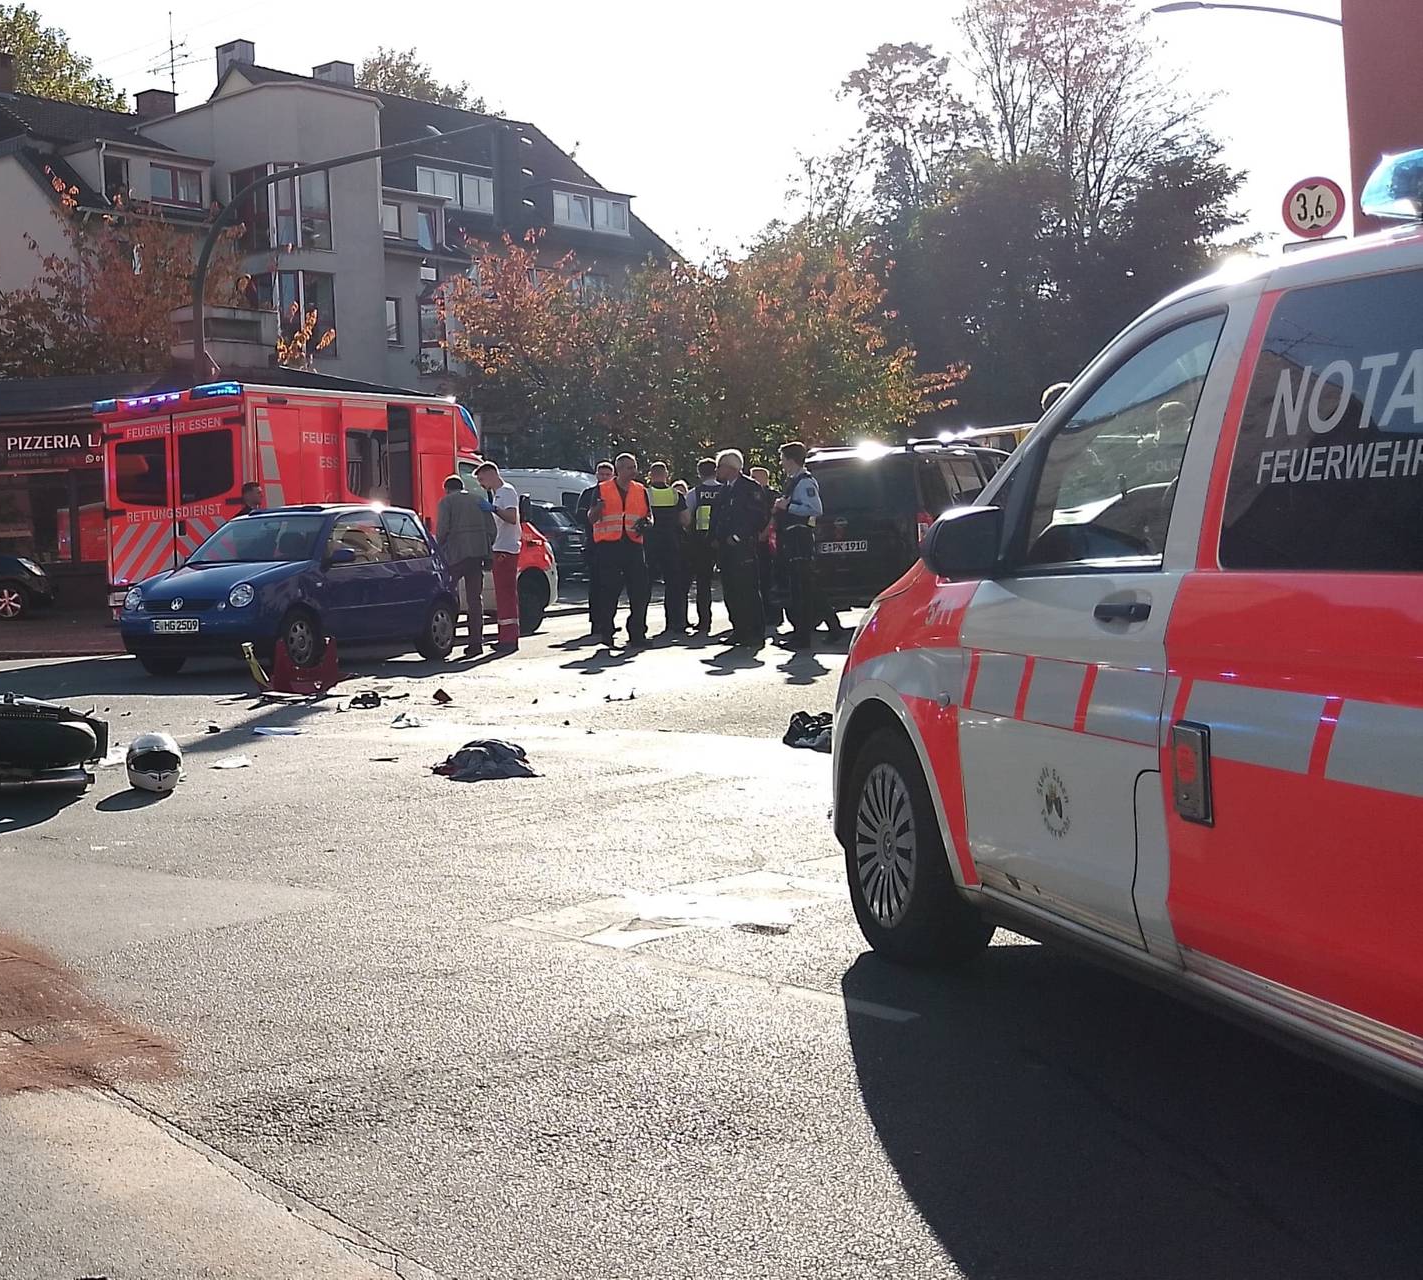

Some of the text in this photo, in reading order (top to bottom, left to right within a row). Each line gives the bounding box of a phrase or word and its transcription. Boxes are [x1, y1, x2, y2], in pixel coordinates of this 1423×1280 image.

[1296, 193, 1324, 222] 3,6
[1265, 348, 1423, 438] NOTA
[127, 417, 222, 439] FEUERWEHR ESSEN
[7, 434, 82, 451] PIZZERIA
[127, 503, 223, 523] RETTUNGSDIENST
[846, 540, 867, 551] 1910
